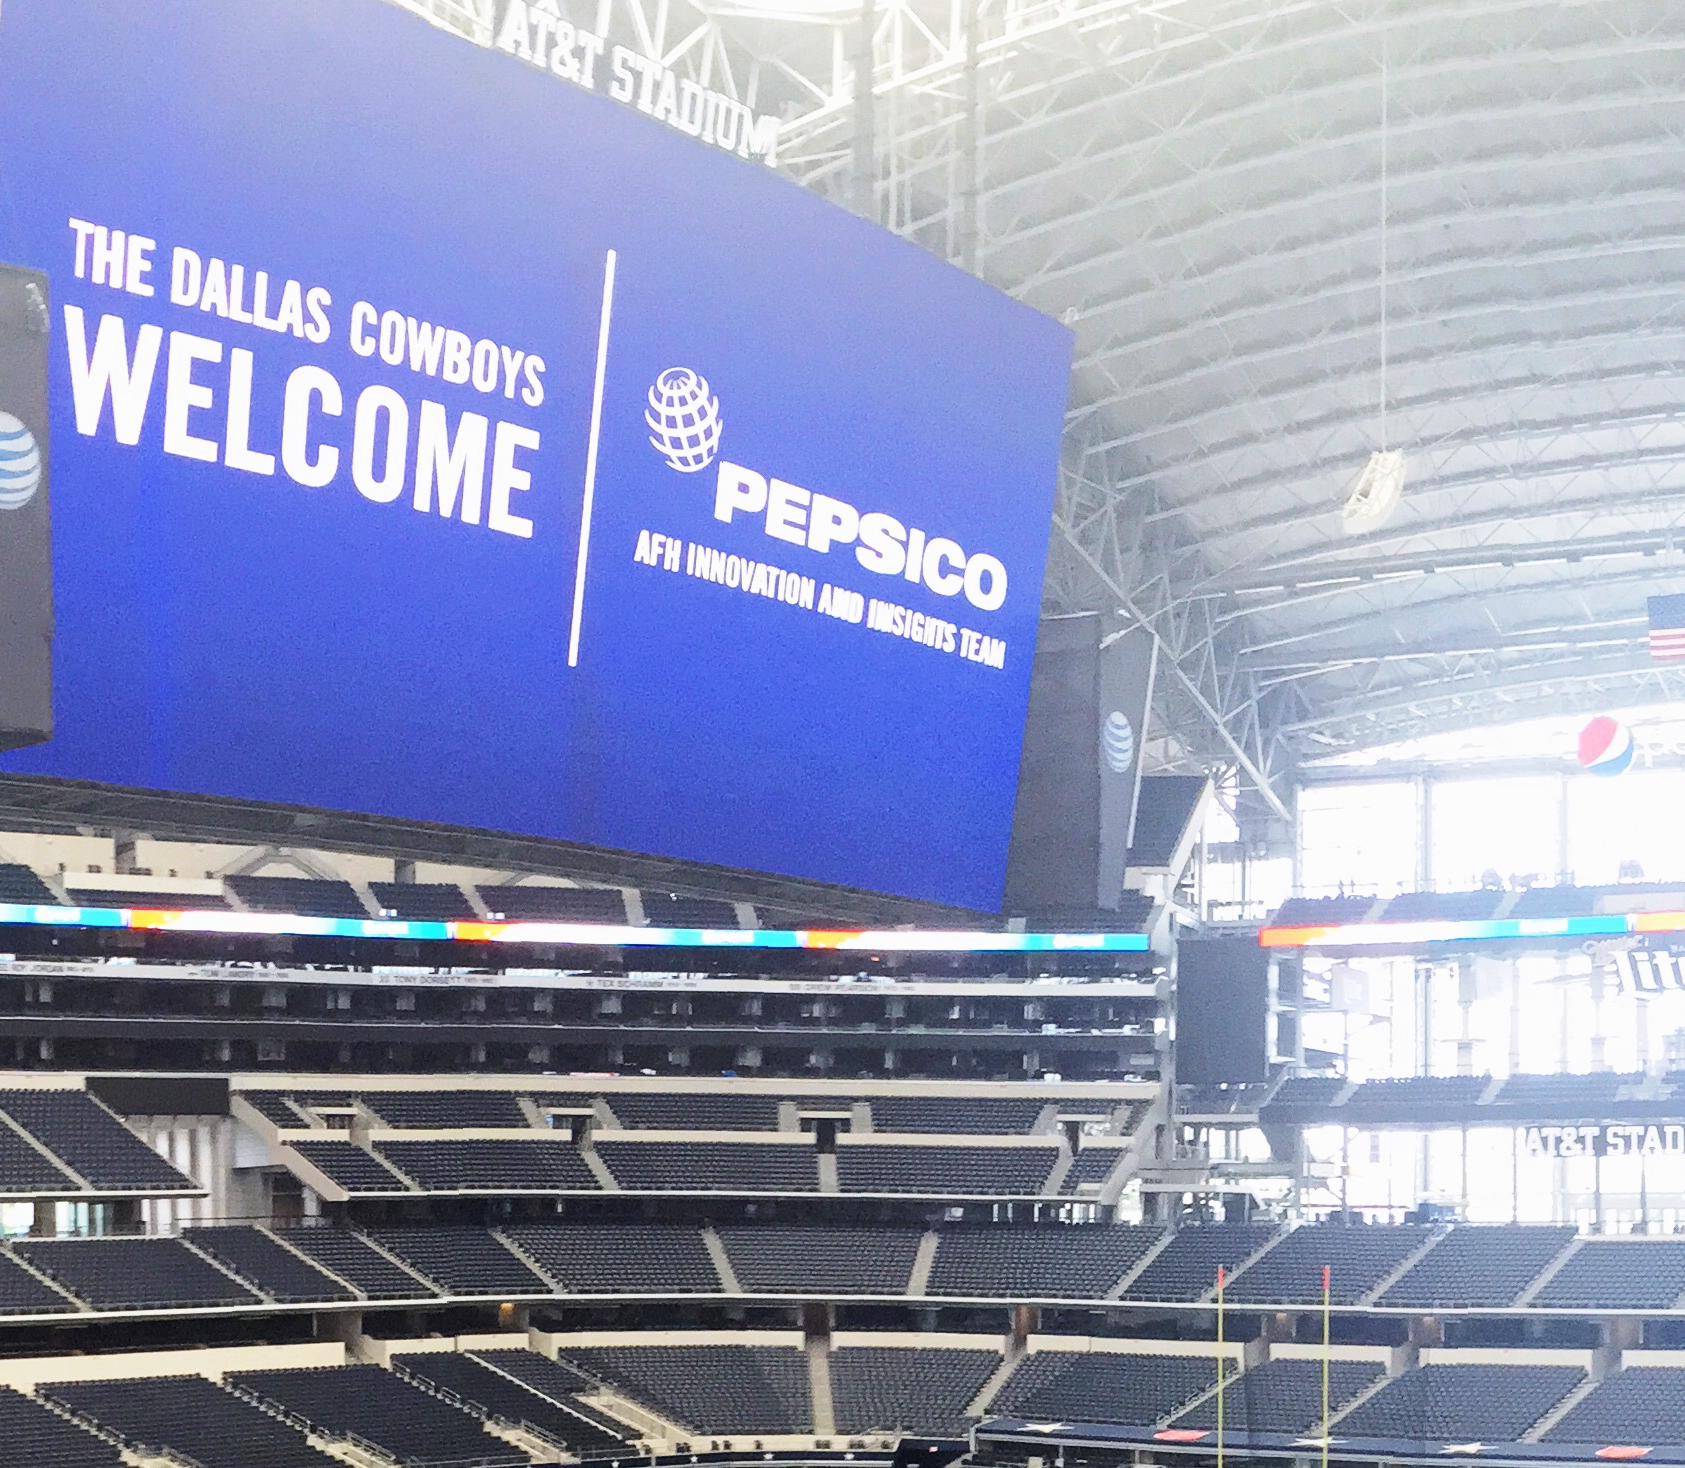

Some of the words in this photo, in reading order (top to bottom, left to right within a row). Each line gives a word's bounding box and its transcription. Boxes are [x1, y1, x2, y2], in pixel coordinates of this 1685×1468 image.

[495, 0, 604, 89] AT&T
[609, 44, 782, 169] STADIUM
[68, 217, 156, 298] THE
[170, 246, 332, 344] DALLAS
[350, 300, 546, 407] COWBOYS
[63, 303, 541, 540] WELCOME
[633, 529, 683, 573] AFH
[685, 542, 817, 610] INNOVATION
[817, 583, 865, 624] AND
[867, 598, 956, 654] INSIGHTS
[960, 627, 1007, 670] TEAM
[714, 460, 1008, 612] PEPSICO
[1525, 1126, 1600, 1157] AT&T
